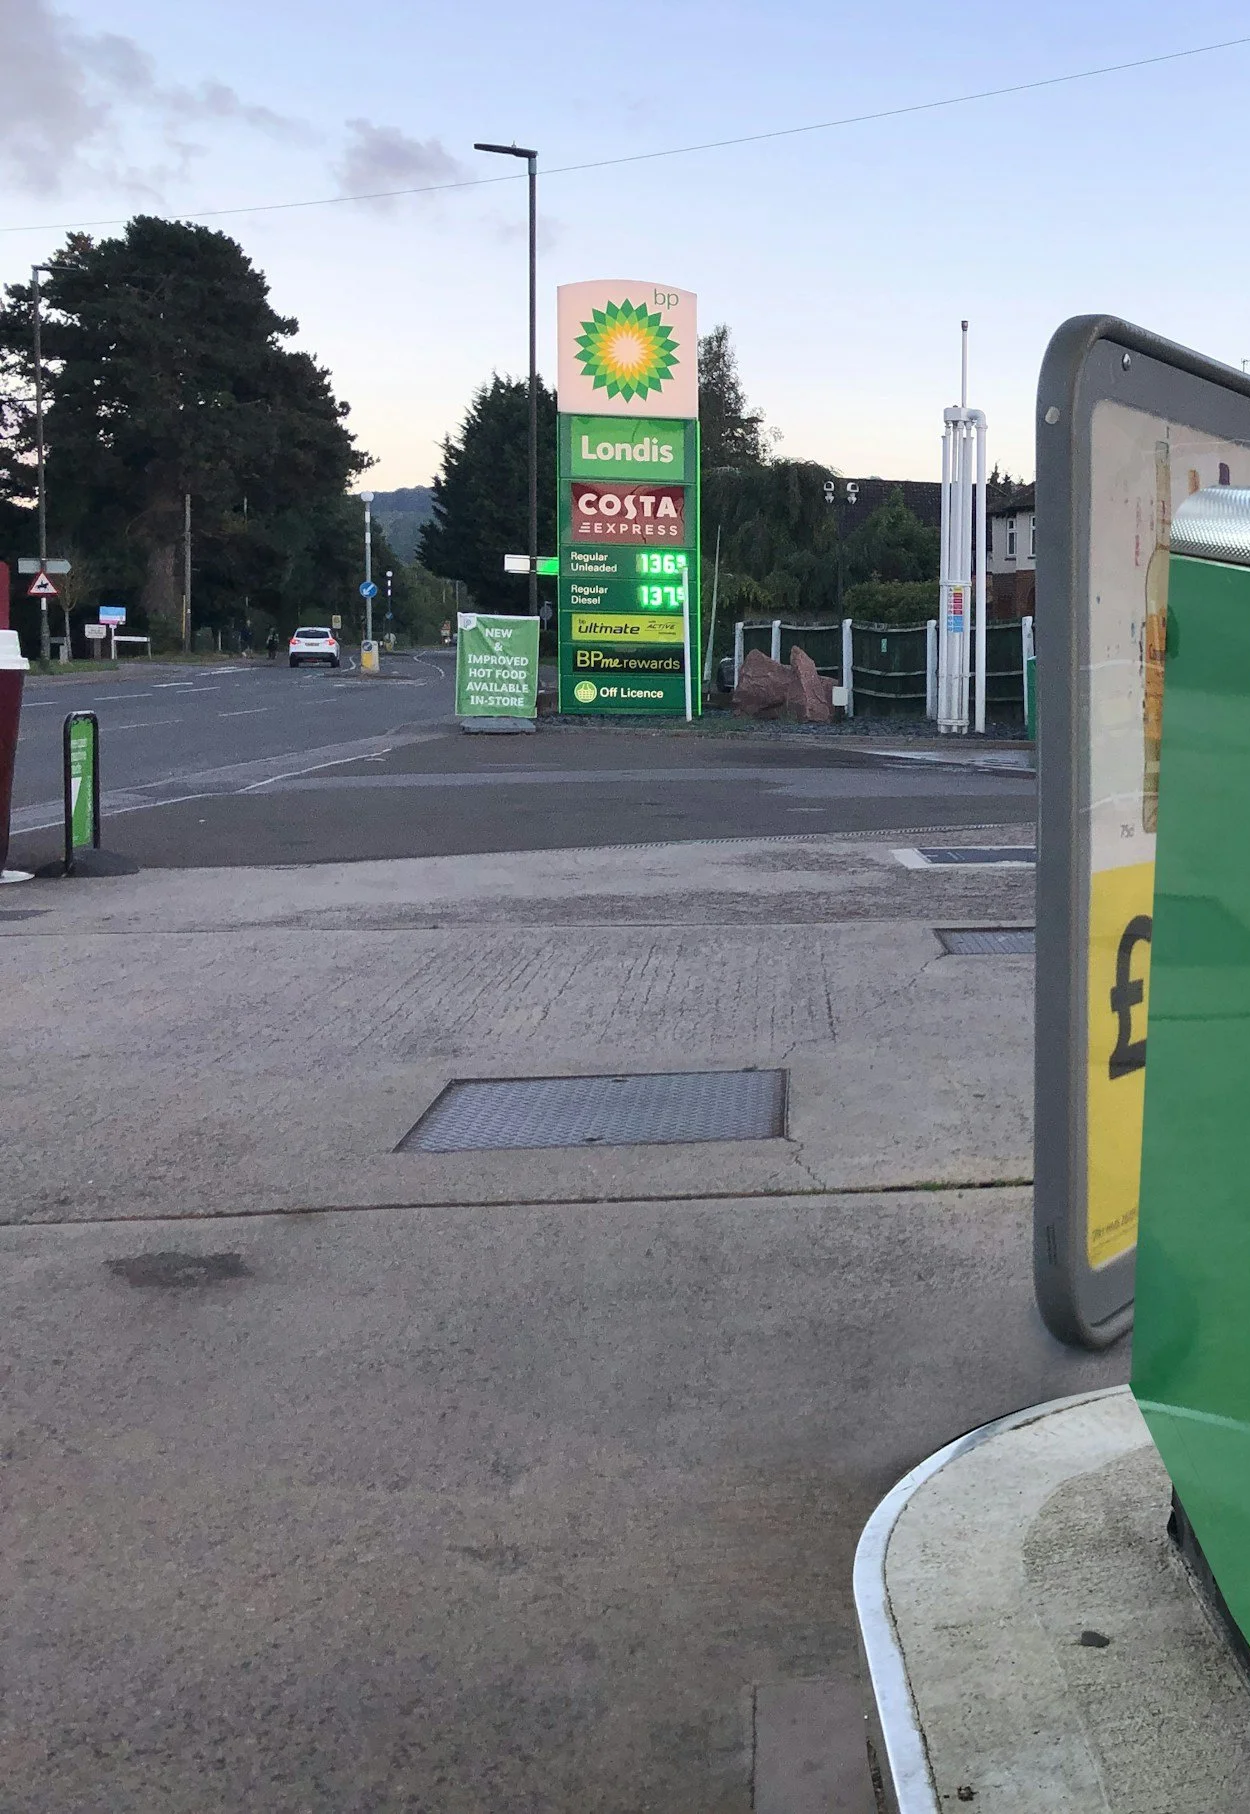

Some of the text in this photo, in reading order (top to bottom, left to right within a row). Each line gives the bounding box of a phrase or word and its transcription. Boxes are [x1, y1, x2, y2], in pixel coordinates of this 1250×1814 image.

[654, 289, 679, 309] bp
[581, 435, 674, 463] Londis
[578, 493, 677, 519] COSTA
[594, 522, 678, 536] EXPRESS
[571, 552, 608, 563] Regular
[571, 563, 617, 573] Unleaded
[571, 584, 608, 595] Regular
[571, 595, 601, 605] Diesel
[485, 628, 512, 638] NEW
[578, 623, 640, 635] ultimate
[494, 642, 503, 652] &
[468, 655, 528, 666] IMPROVED
[623, 657, 681, 670] rewards
[468, 668, 527, 680] HOT FOOD
[466, 681, 529, 693] AVAILABLE
[600, 687, 664, 699] Off Licence
[470, 694, 525, 707] IN-STORE
